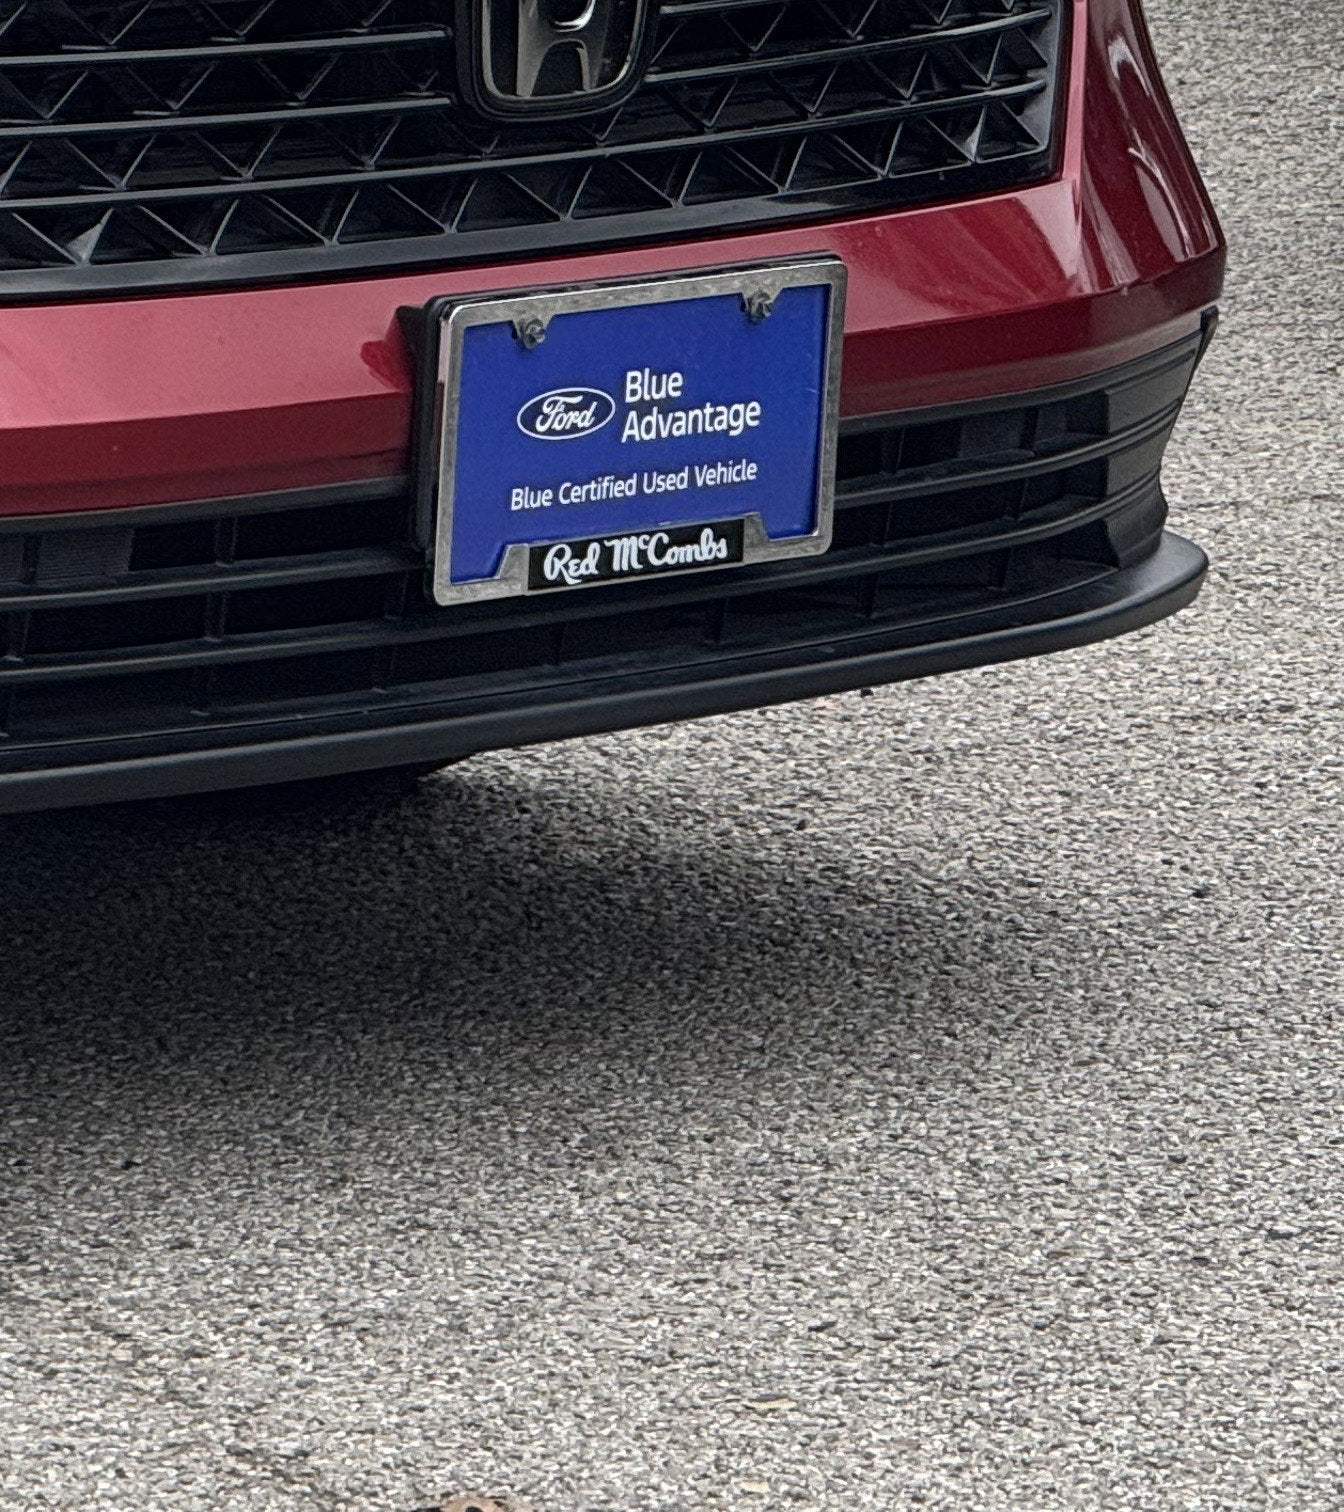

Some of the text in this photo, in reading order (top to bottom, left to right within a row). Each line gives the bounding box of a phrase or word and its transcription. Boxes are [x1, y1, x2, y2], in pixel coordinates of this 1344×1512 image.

[624, 367, 684, 403] Blue
[535, 394, 598, 433] Ford
[621, 400, 762, 444] Advantage
[511, 458, 758, 511] Blue Certified Used Vehicle
[543, 527, 729, 585] Red McCombs
